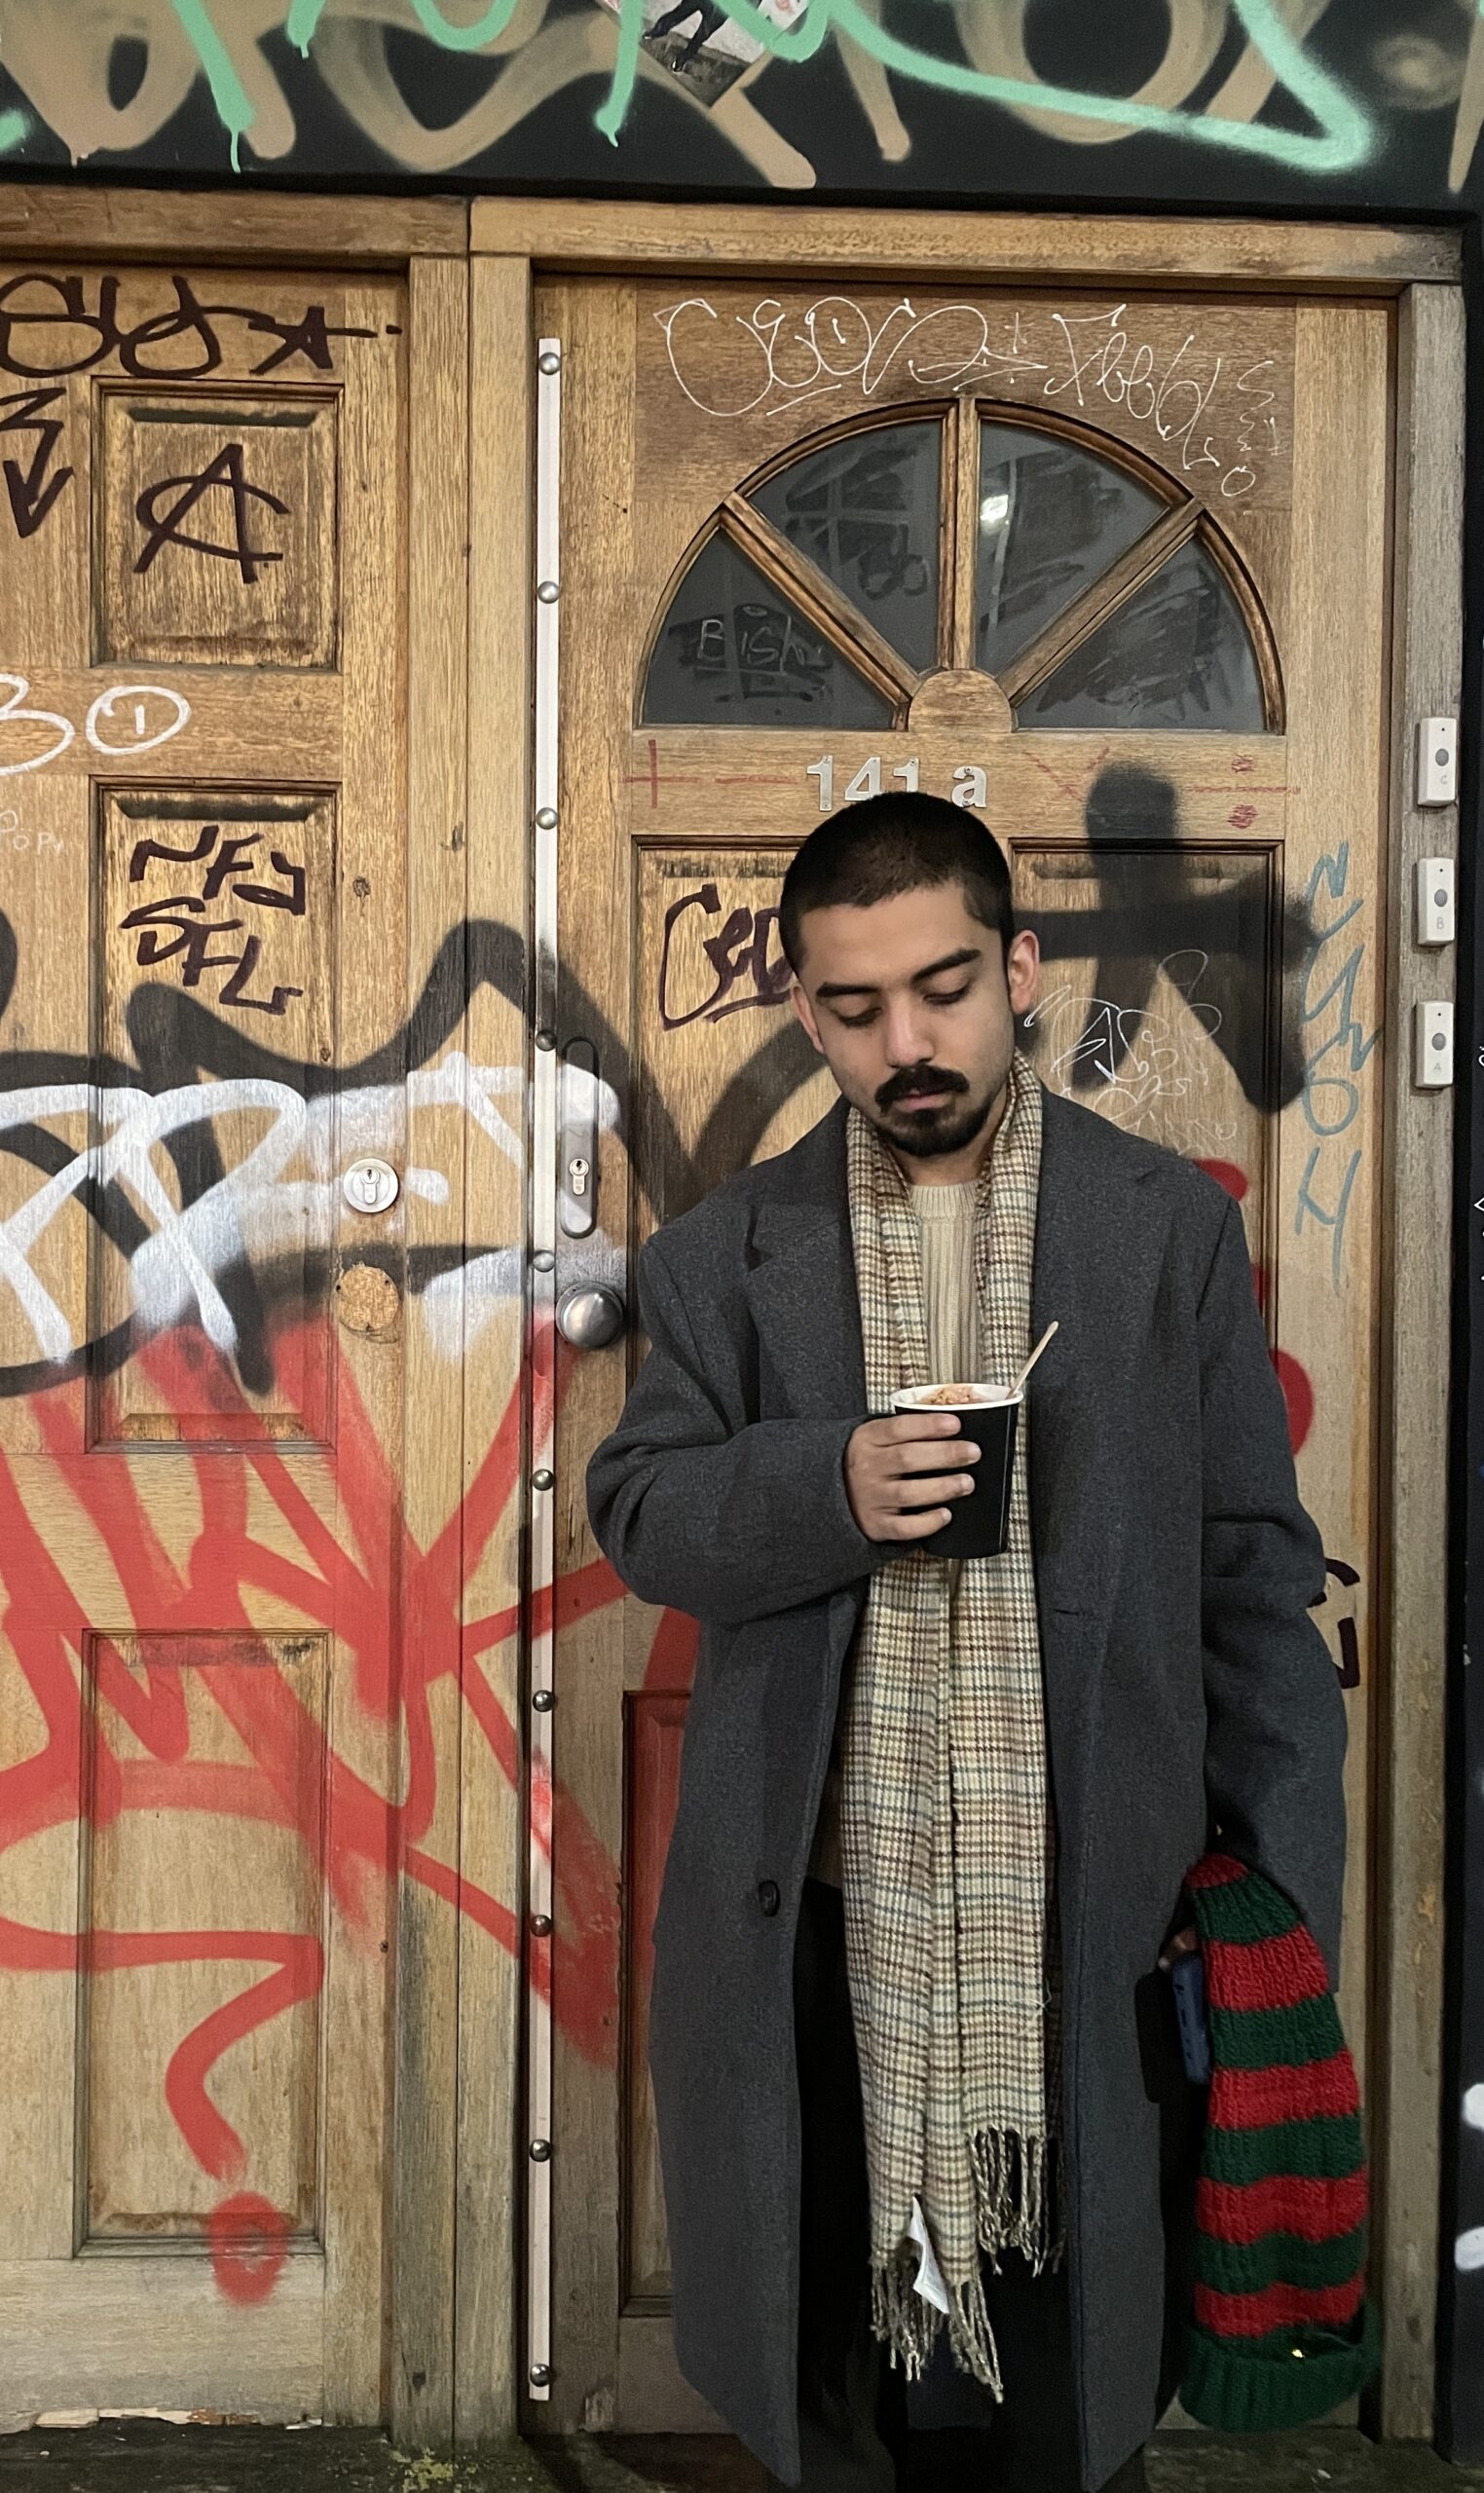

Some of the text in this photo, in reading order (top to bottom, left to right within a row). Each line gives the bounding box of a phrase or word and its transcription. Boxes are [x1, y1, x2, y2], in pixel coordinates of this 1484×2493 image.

[806, 755, 987, 811] 141 a
[1435, 916, 1445, 930] B
